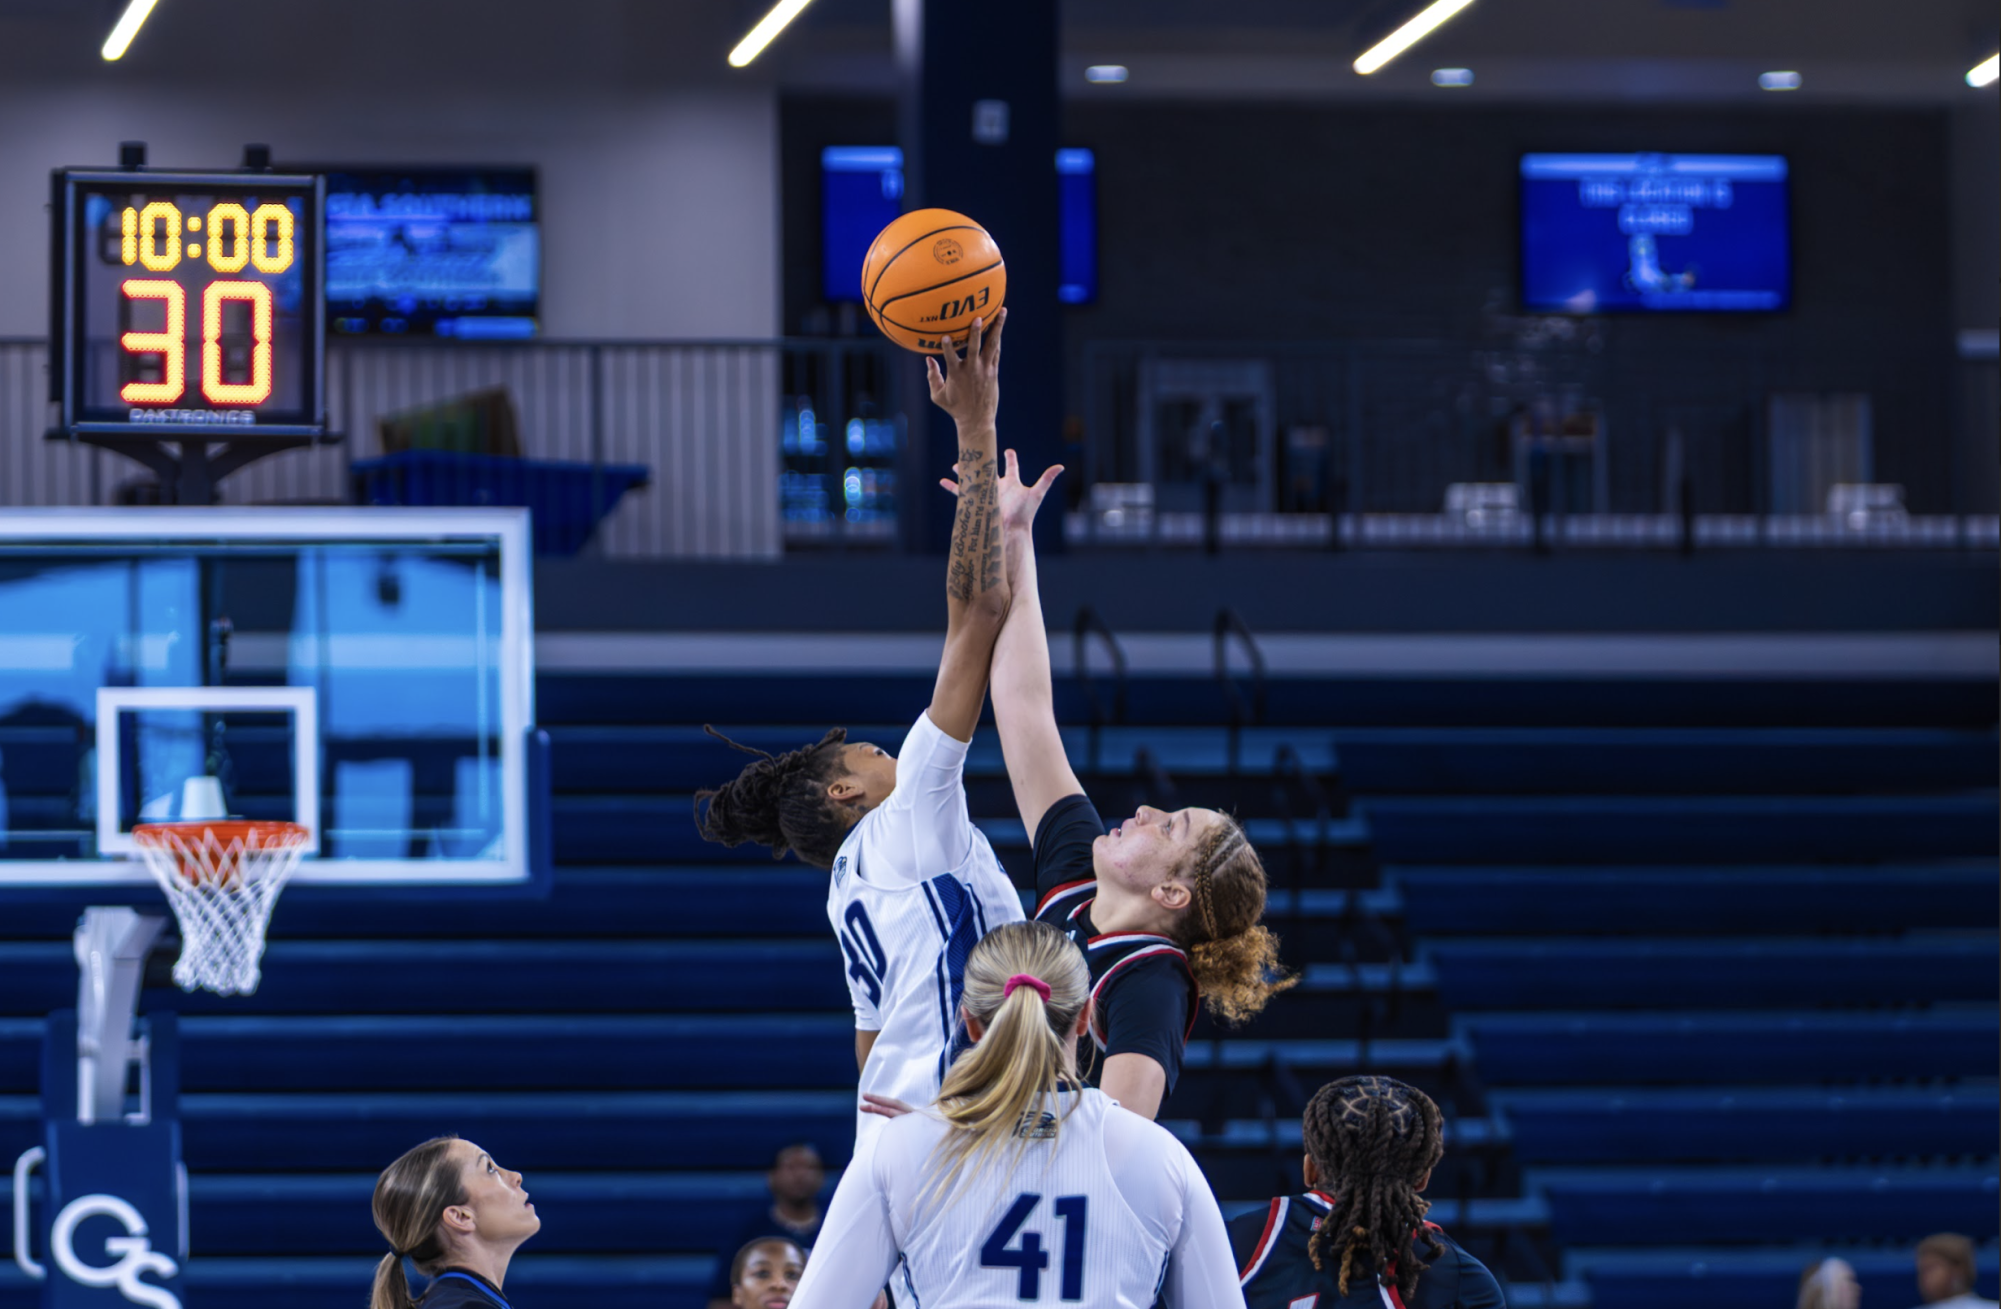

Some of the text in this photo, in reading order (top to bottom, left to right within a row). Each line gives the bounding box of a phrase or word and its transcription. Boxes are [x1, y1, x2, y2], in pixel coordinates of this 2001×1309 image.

[122, 202, 294, 273] 10:00
[918, 285, 990, 323] EVO NXT
[120, 279, 272, 404] 30
[129, 408, 256, 425] DAKTRONICS
[979, 1191, 1088, 1303] 41
